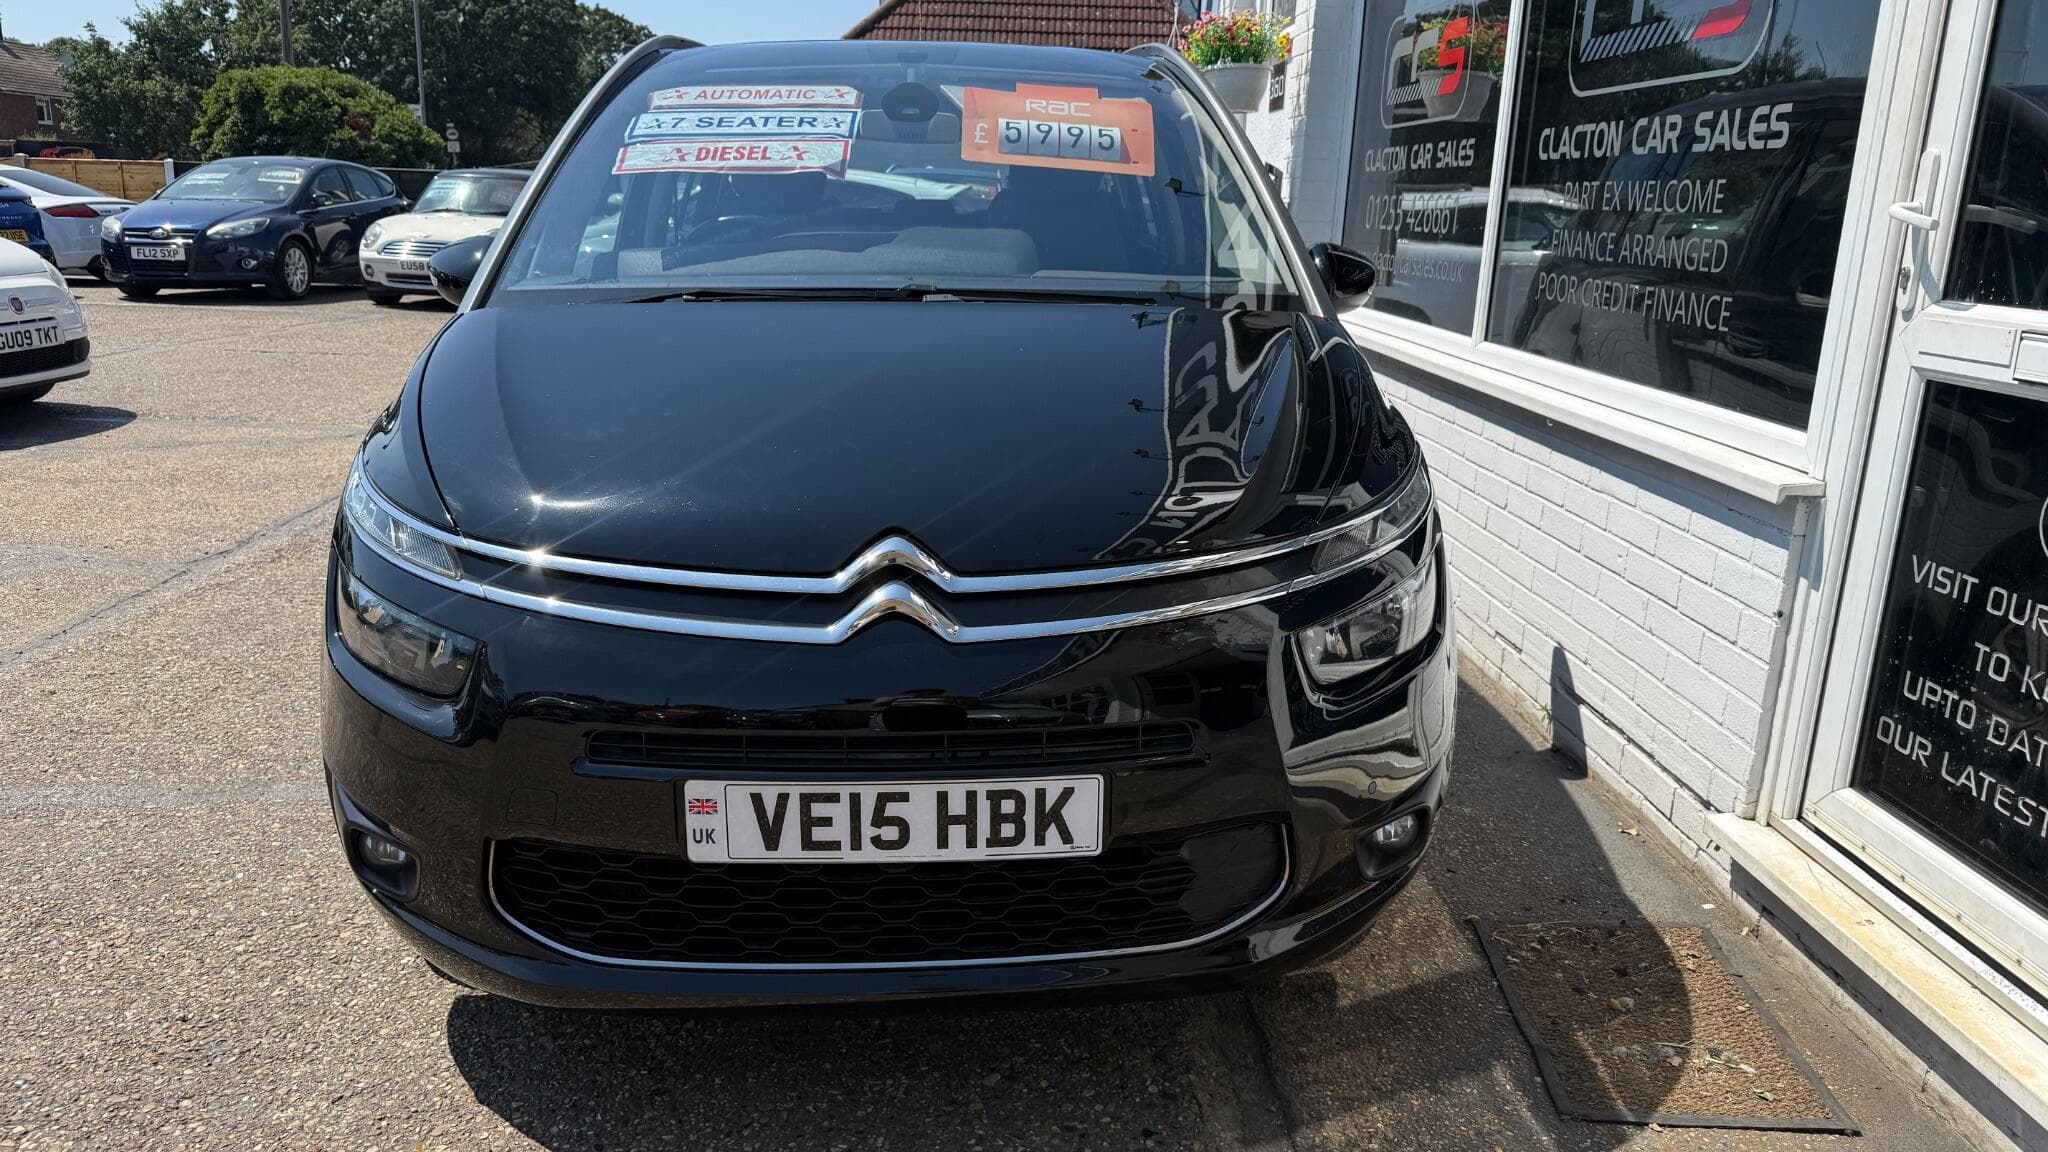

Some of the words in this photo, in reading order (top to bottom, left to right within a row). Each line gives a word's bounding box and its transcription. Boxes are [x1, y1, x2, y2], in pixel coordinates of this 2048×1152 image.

[694, 88, 817, 101] AUTOMATIC
[671, 117, 684, 128] 7
[695, 116, 818, 129] SEATER
[973, 123, 989, 144] £
[1005, 121, 1115, 151] 5995
[1538, 120, 1624, 161] CLACTON
[1632, 114, 1682, 155] CAR
[1692, 103, 1793, 152] SALES
[695, 145, 772, 162] DIESEL
[1365, 145, 1407, 173] CLACTON
[1410, 143, 1433, 169] CAR
[1436, 138, 1476, 168] SALES
[1365, 193, 1404, 231] 01255
[1406, 192, 1460, 234] 426661
[1563, 181, 1600, 211] PART
[1603, 181, 1623, 211] EX
[1628, 178, 1727, 214] WELCOME
[136, 248, 158, 258] FL12
[160, 248, 179, 258] SXP
[1551, 229, 1616, 263] FINANCE
[1618, 234, 1729, 274] ARRANGED
[1537, 271, 1577, 305] POOR
[1581, 277, 1641, 315] CREDIT
[1642, 286, 1733, 332] FINANCE
[0, 330, 33, 350] GU09
[35, 326, 58, 344] TKT
[1912, 554, 1979, 604] VISIT
[1986, 586, 2048, 636] OUR
[1974, 641, 2010, 682] TO
[1903, 670, 1977, 729] UPTO
[1876, 715, 1932, 768] OUR
[692, 828, 716, 844] UK
[749, 791, 911, 851] VE15
[936, 787, 1075, 849] HBK
